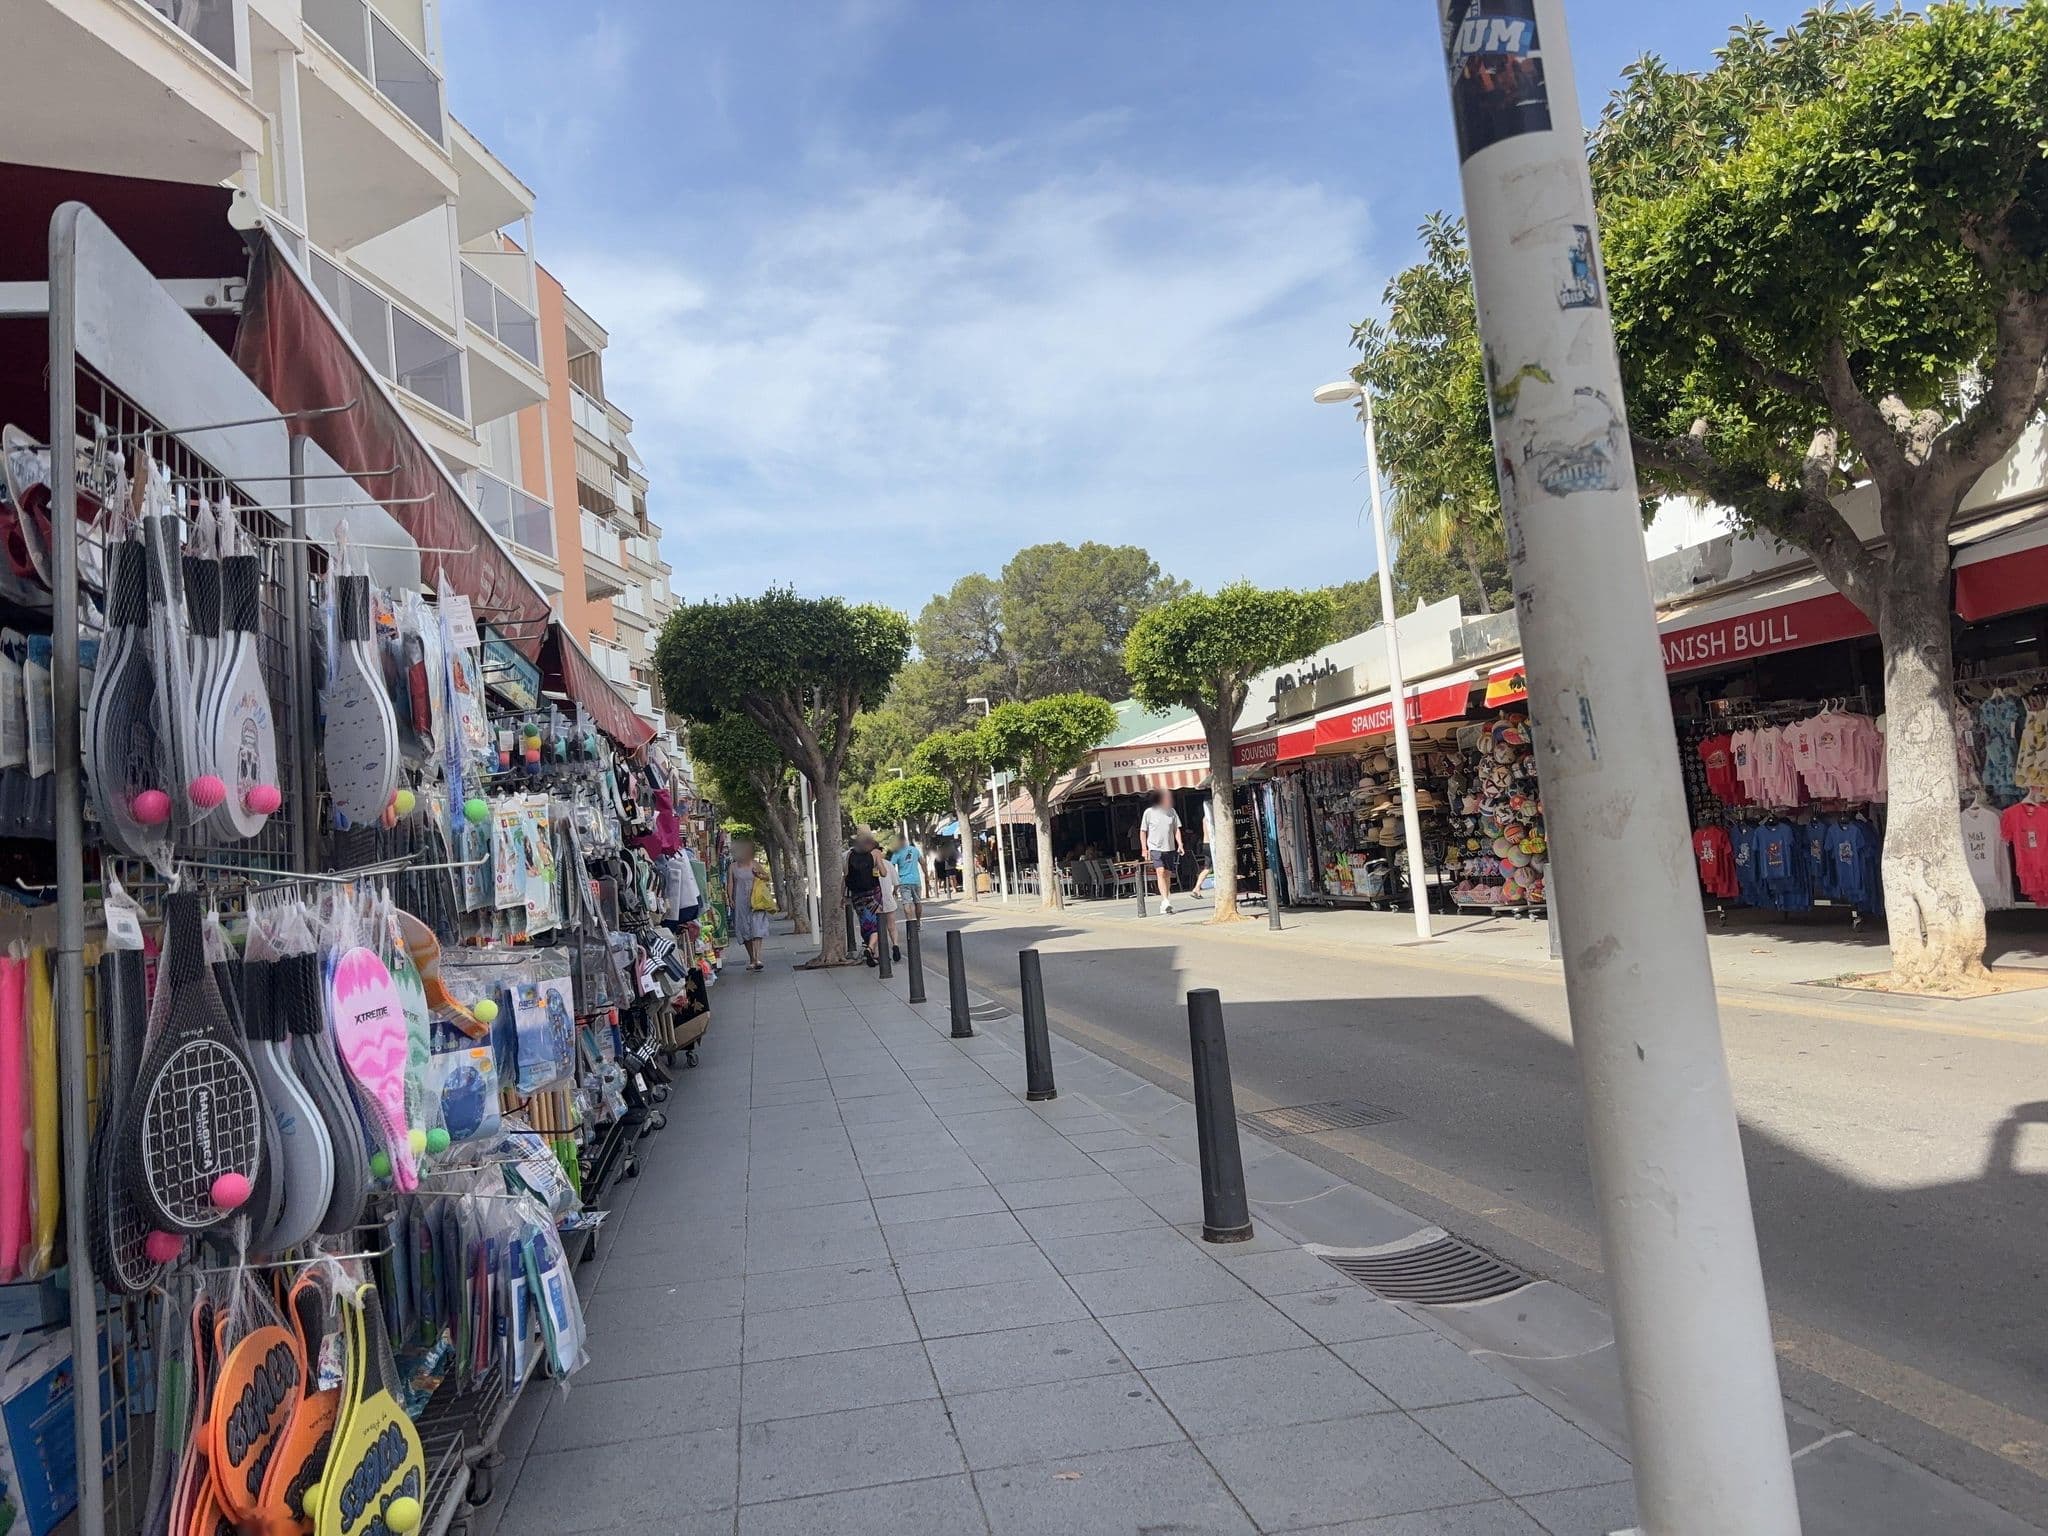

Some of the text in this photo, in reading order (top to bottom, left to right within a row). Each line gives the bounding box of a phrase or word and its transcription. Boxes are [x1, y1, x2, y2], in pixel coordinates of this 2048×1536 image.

[1660, 614, 1798, 665] ANISH BULL
[1351, 709, 1393, 733] SPANISH
[1113, 751, 1209, 768] HOT DOGS HAM
[1155, 743, 1208, 755] SANDWIC
[1241, 742, 1278, 762] SOUVENIR
[354, 1005, 388, 1025] XTREME
[195, 1111, 206, 1147] SPORT
[198, 1090, 214, 1170] MALLORCA
